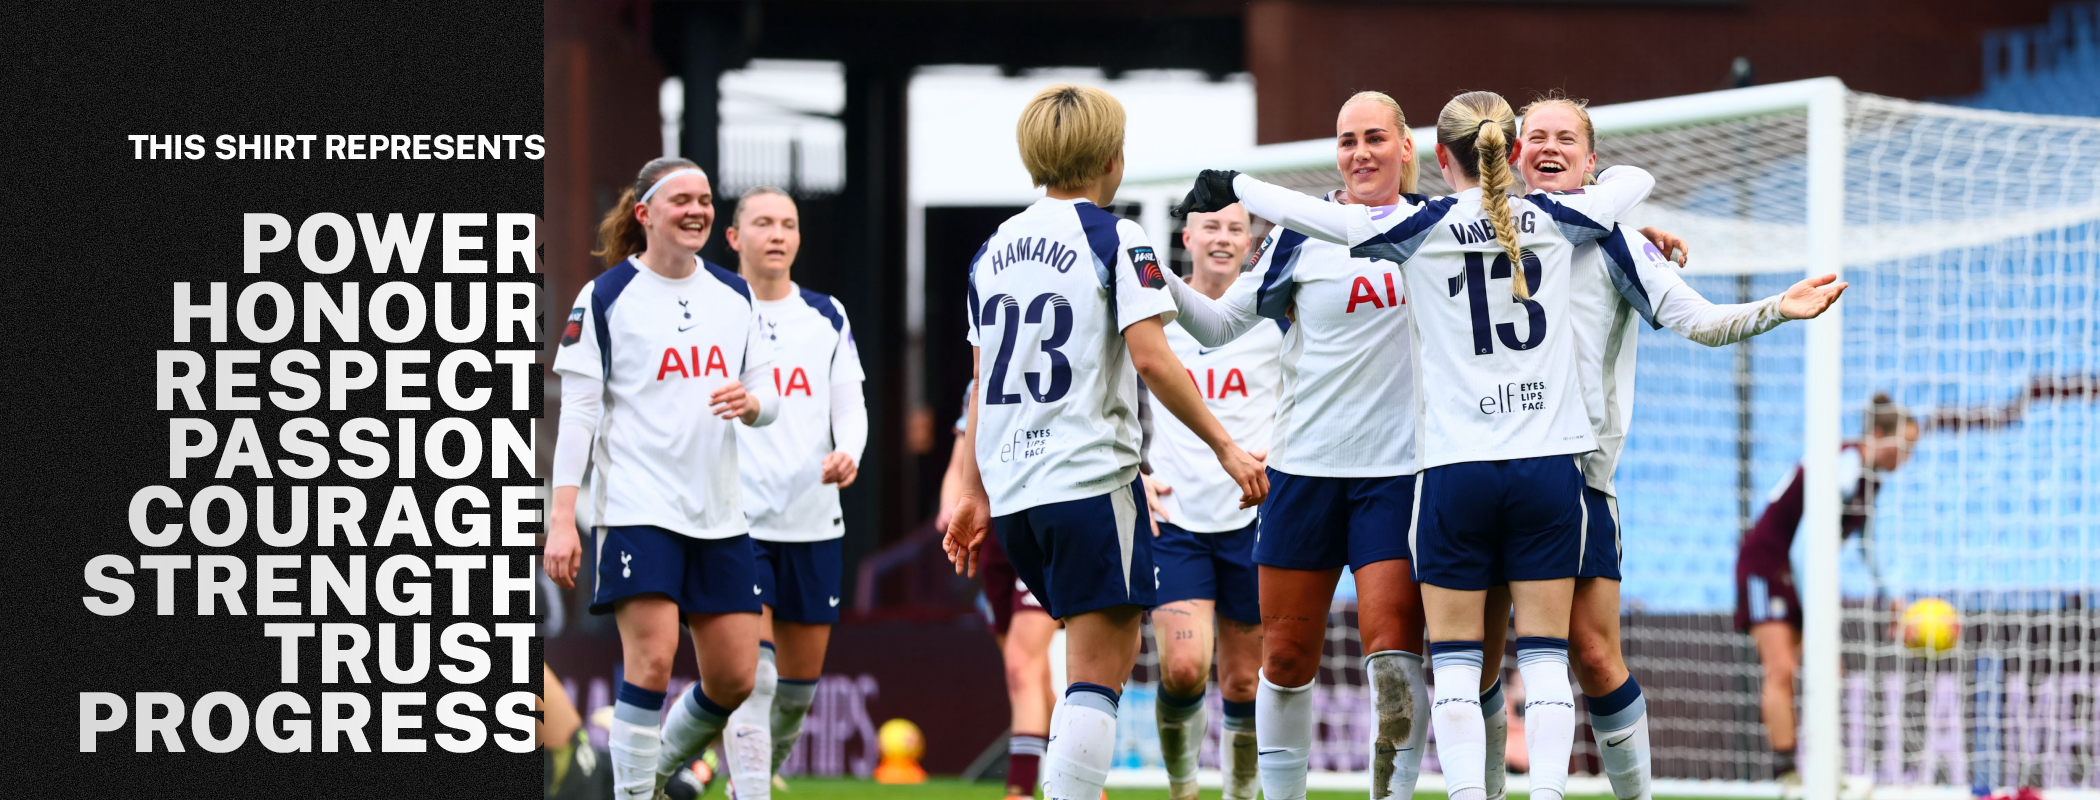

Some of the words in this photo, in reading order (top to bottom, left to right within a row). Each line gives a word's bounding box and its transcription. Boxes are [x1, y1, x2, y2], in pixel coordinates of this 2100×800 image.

[991, 236, 1078, 275] HAMANO
[1346, 272, 1407, 314] AI
[1447, 249, 1547, 356] 13
[657, 345, 729, 381] AIA
[981, 292, 1074, 405] 23
[773, 366, 812, 397] IA
